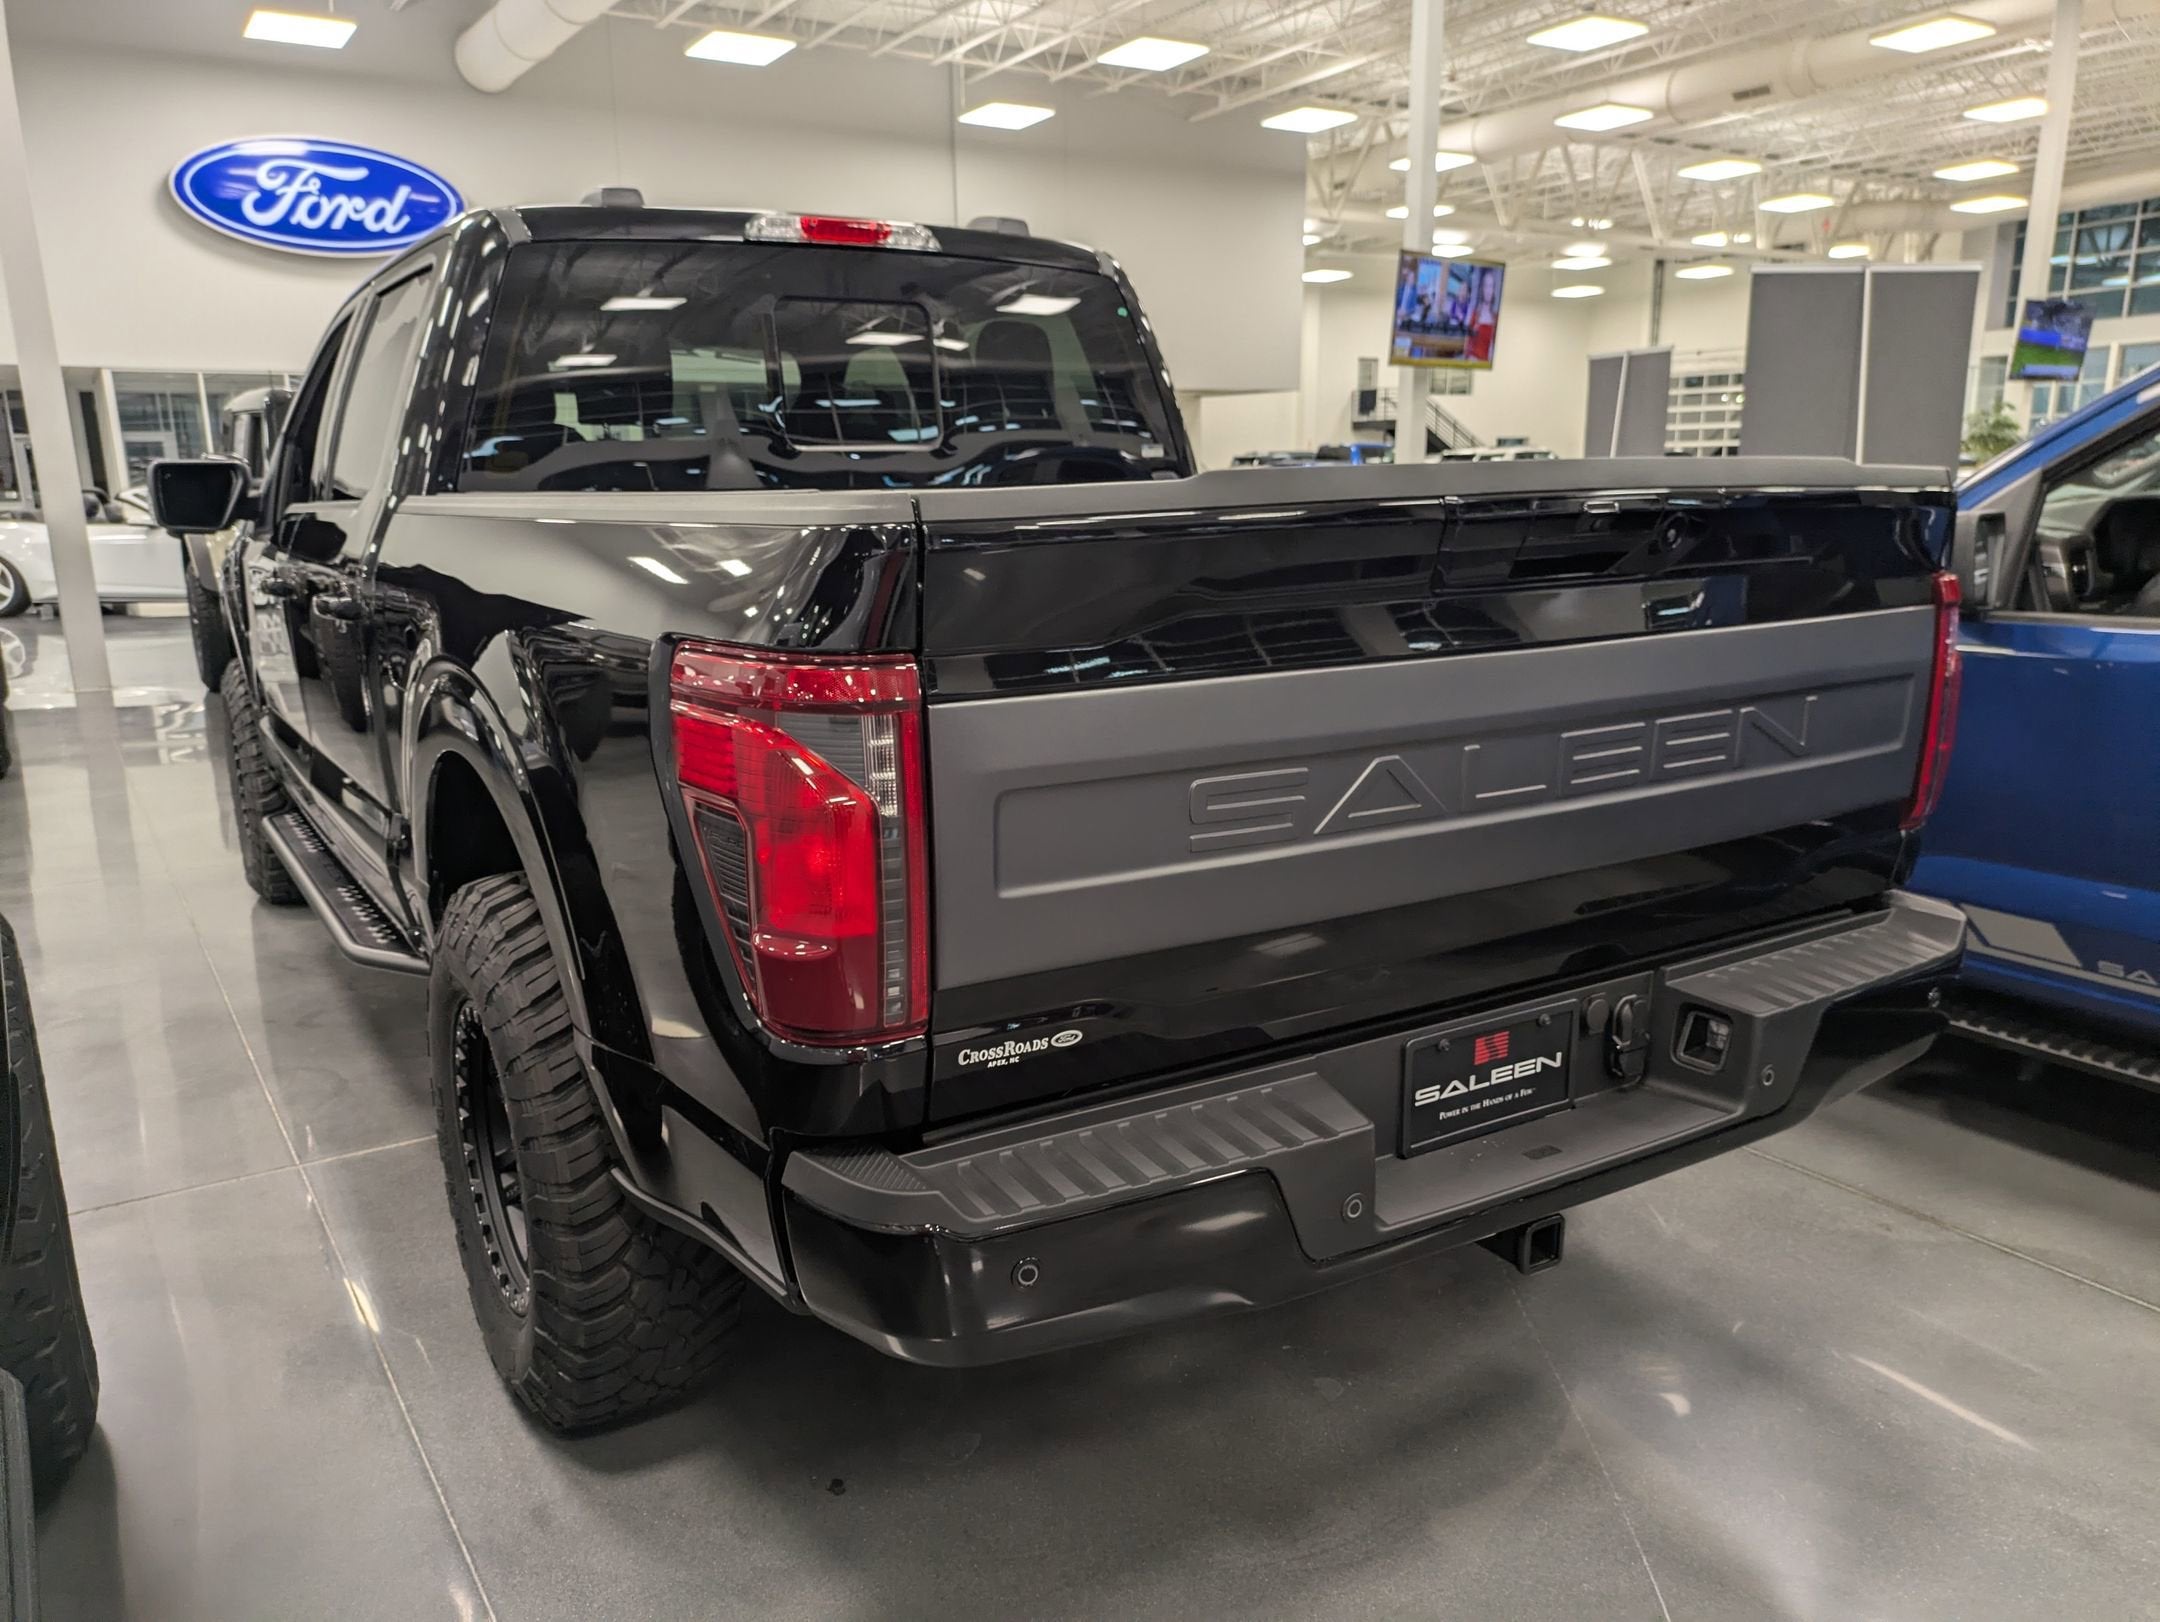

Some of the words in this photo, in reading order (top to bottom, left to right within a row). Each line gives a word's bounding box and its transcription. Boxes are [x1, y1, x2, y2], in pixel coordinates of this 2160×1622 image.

[241, 158, 412, 234] Ford
[1188, 695, 1819, 854] SALEEN
[987, 1058, 1008, 1068] APEX,
[1009, 1056, 1020, 1064] NC
[1414, 1051, 1562, 1107] SALEEN
